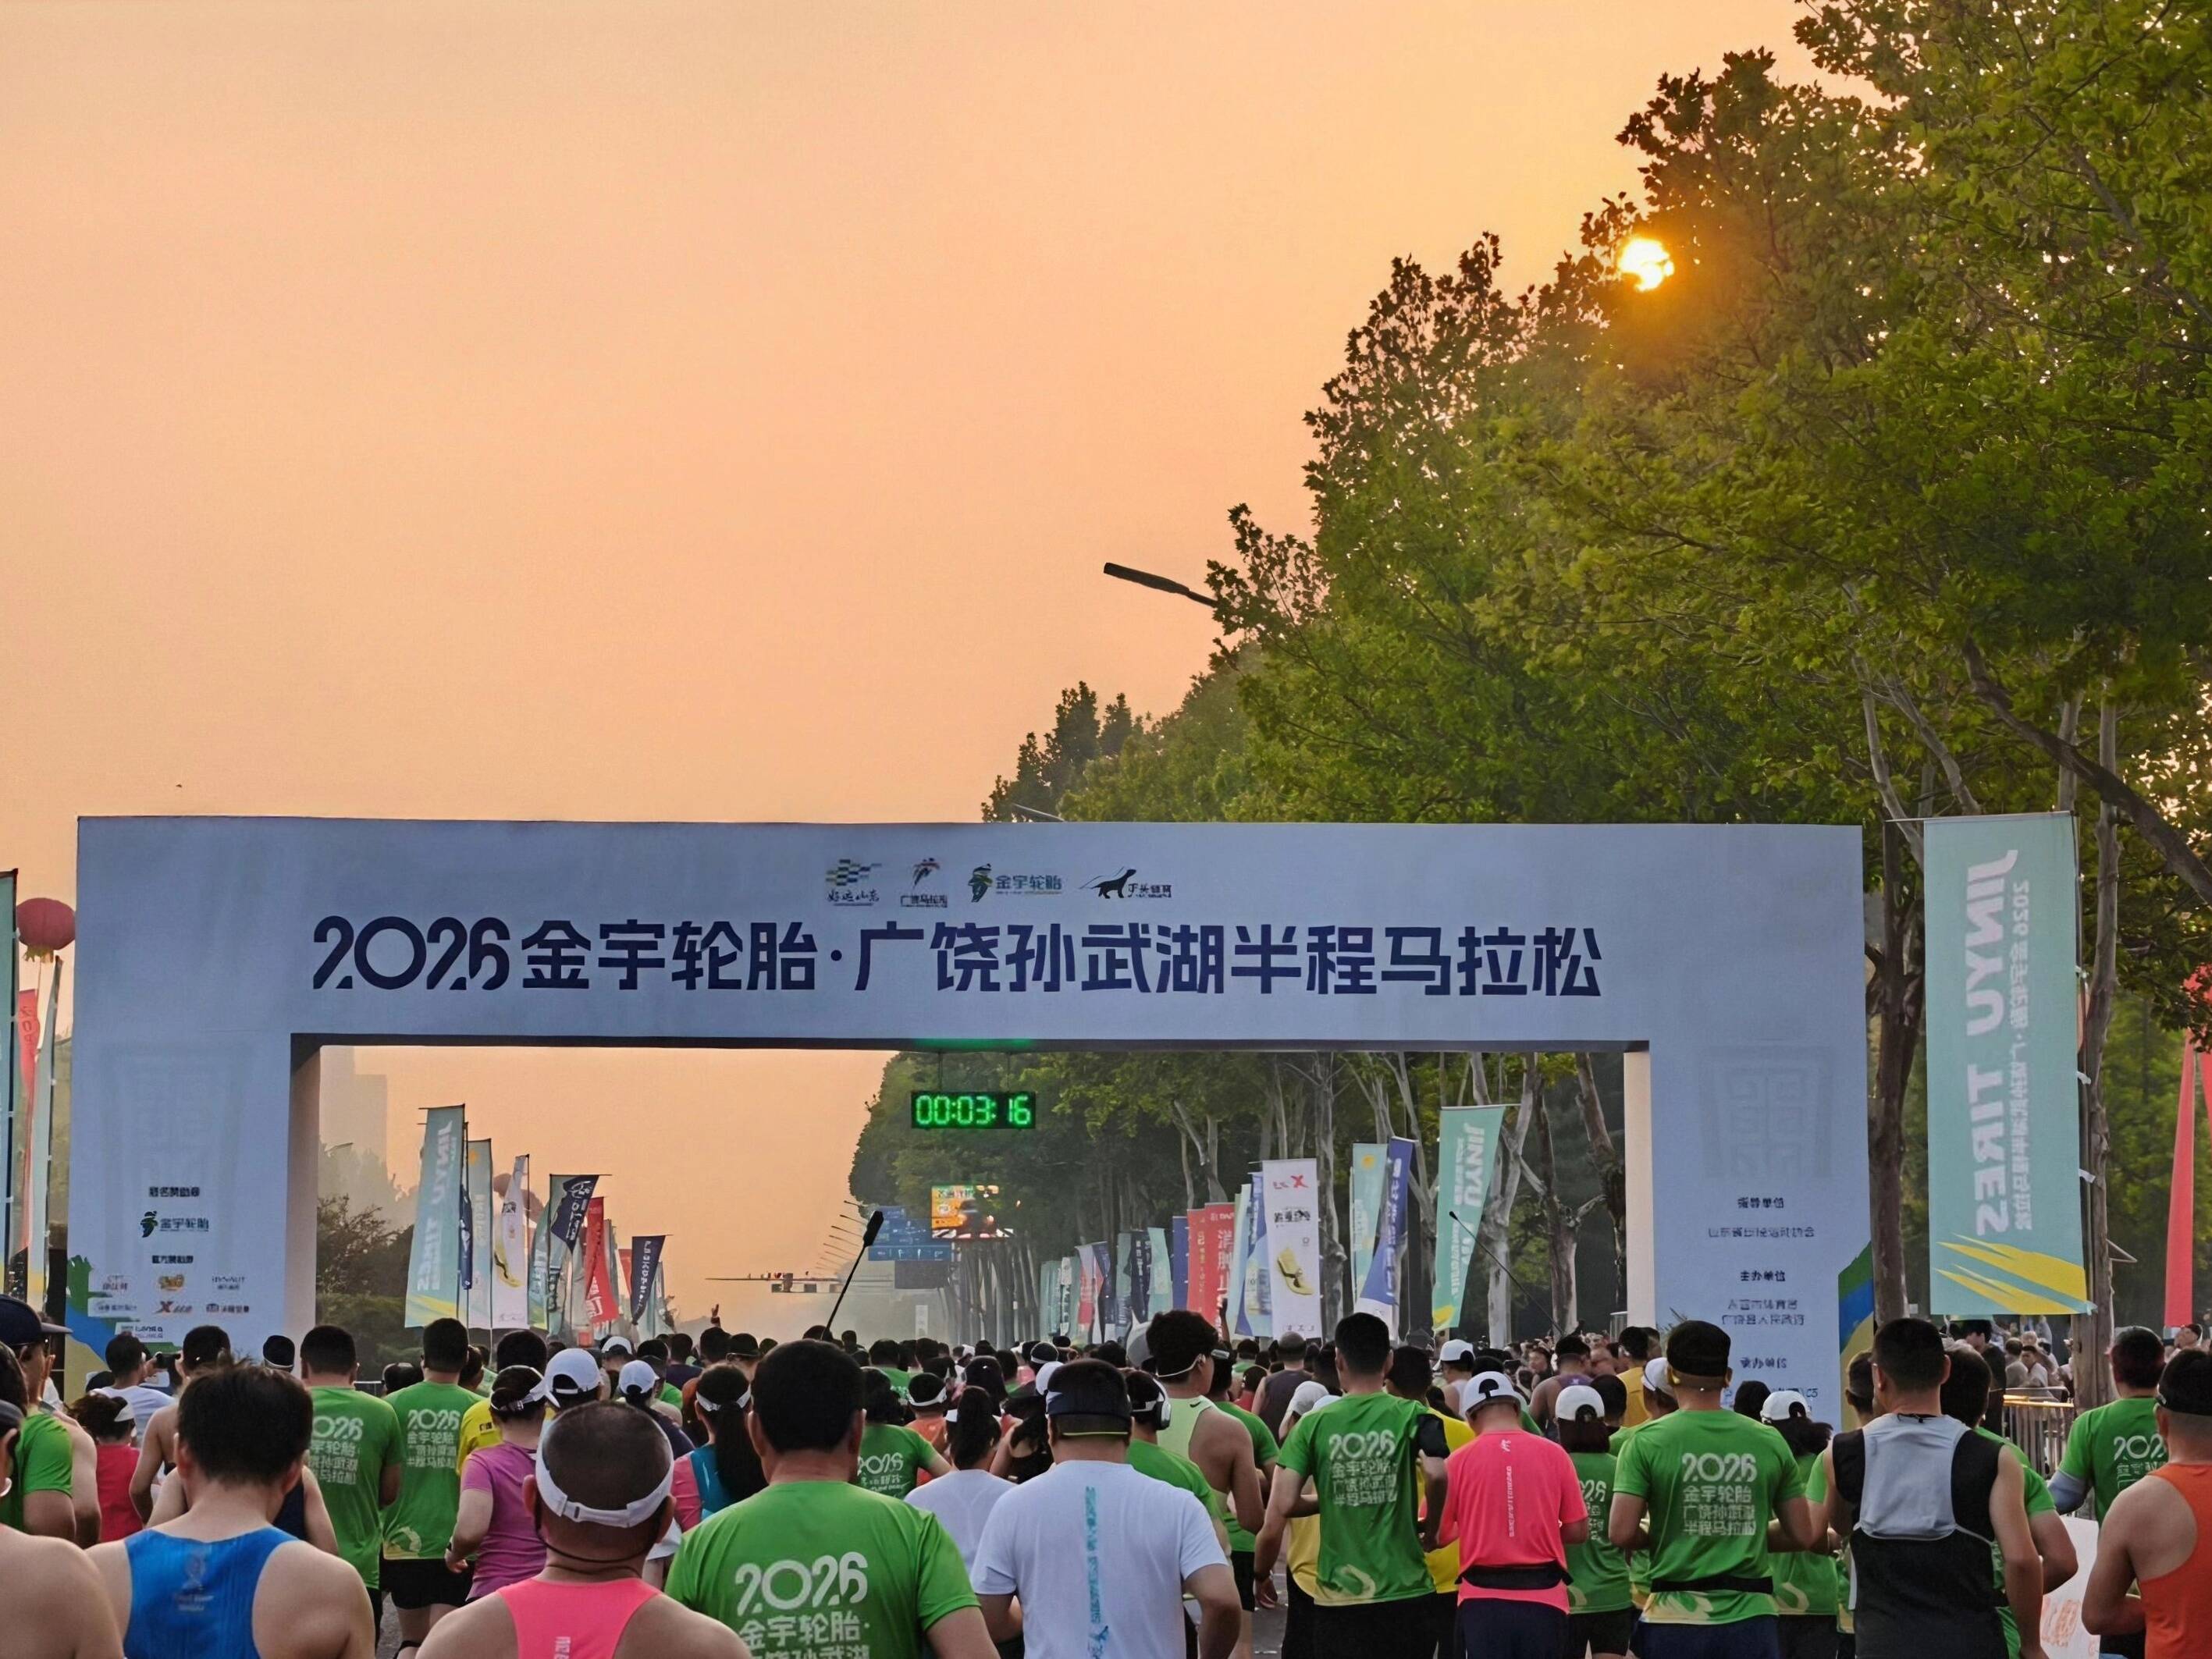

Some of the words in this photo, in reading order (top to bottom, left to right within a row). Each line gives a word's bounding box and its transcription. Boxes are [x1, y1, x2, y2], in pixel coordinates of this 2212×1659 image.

[995, 874, 1062, 890] 金宇轮胎
[916, 1095, 1032, 1125] 00:03:16
[1463, 1122, 1485, 1207] JINYU
[1740, 1270, 1786, 1282] 主办单位
[311, 1416, 365, 1441] 026
[407, 1408, 461, 1430] 2026
[1328, 1430, 1396, 1462] 2026
[2113, 1433, 2168, 1461] 202
[1681, 1452, 1758, 1483] 2026
[1683, 1484, 1752, 1503] 金宇轮胎
[734, 1551, 869, 1618] 2026
